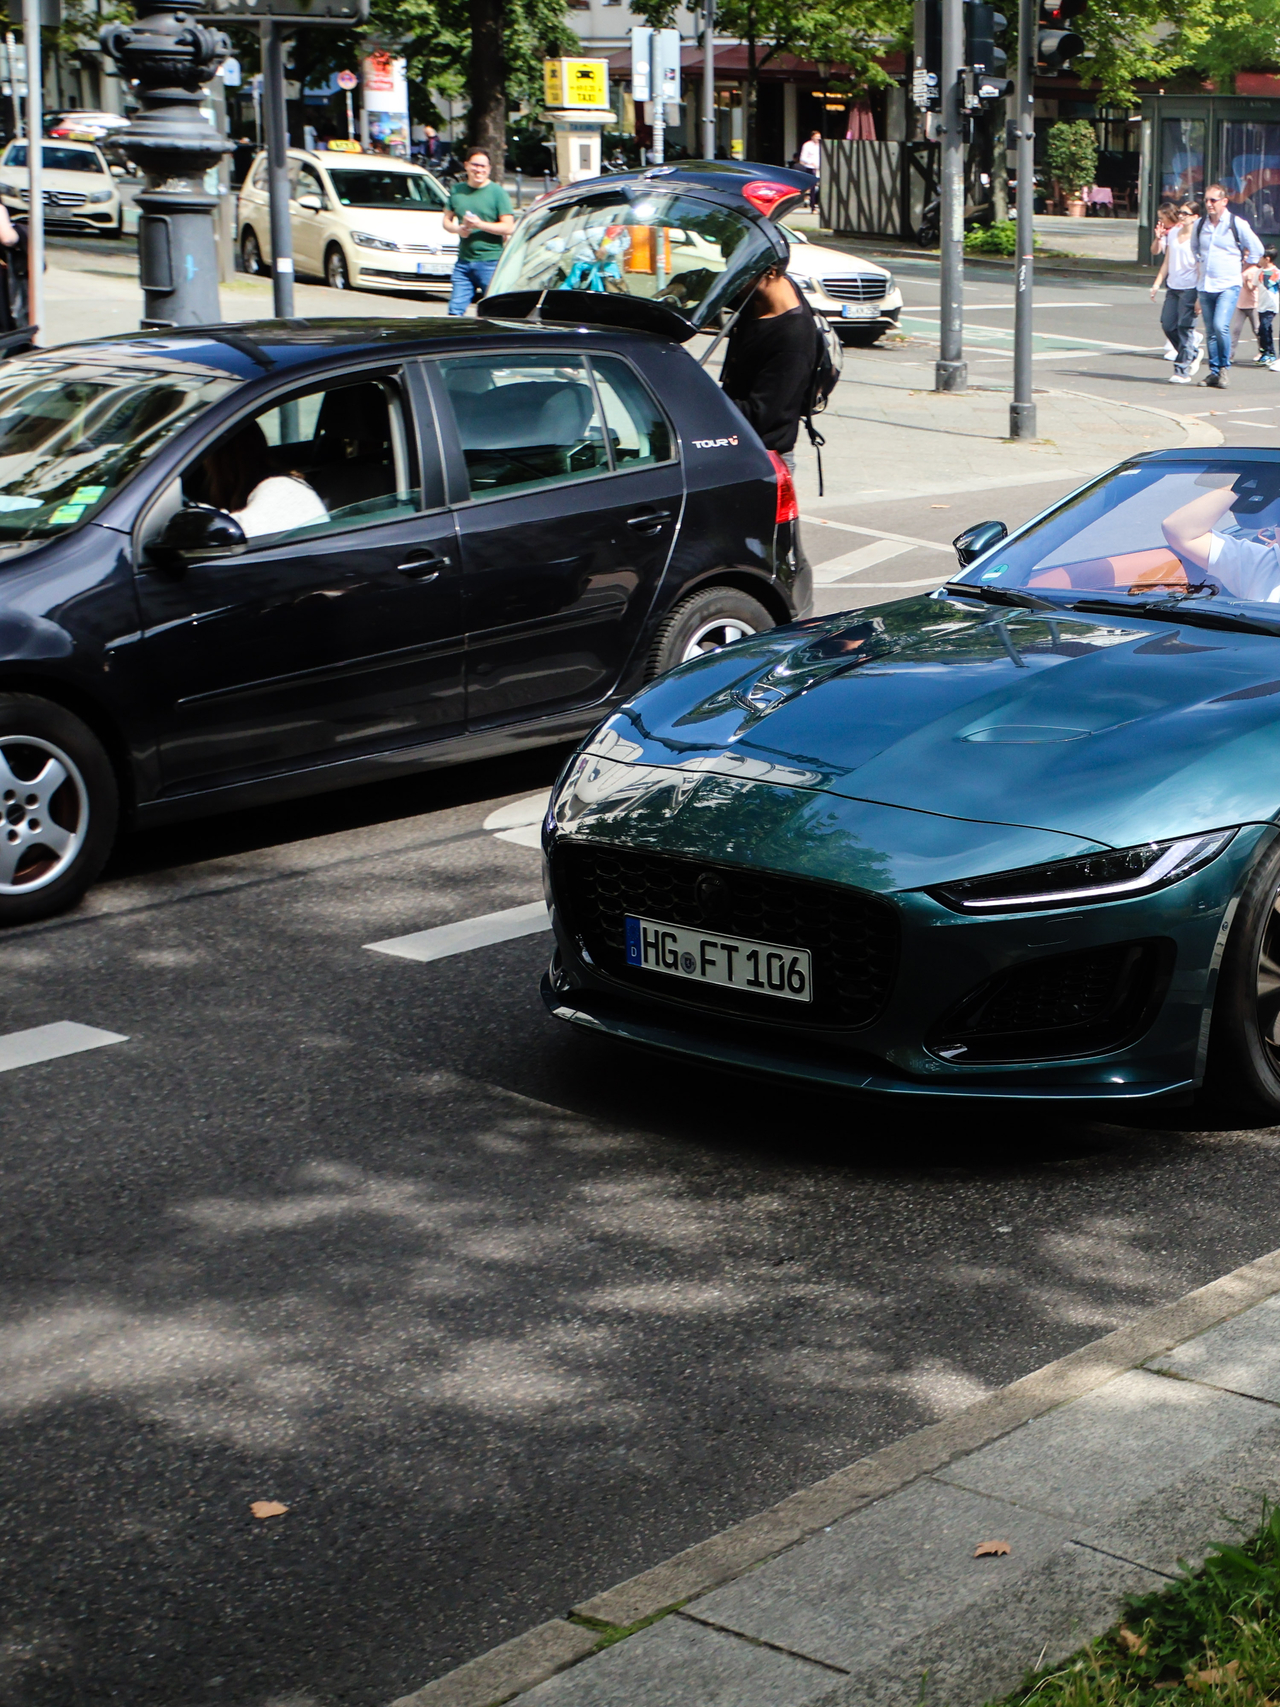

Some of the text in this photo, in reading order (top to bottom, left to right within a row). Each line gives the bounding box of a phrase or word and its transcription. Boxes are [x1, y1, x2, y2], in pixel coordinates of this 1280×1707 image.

[642, 926, 806, 994] HG FT 106
